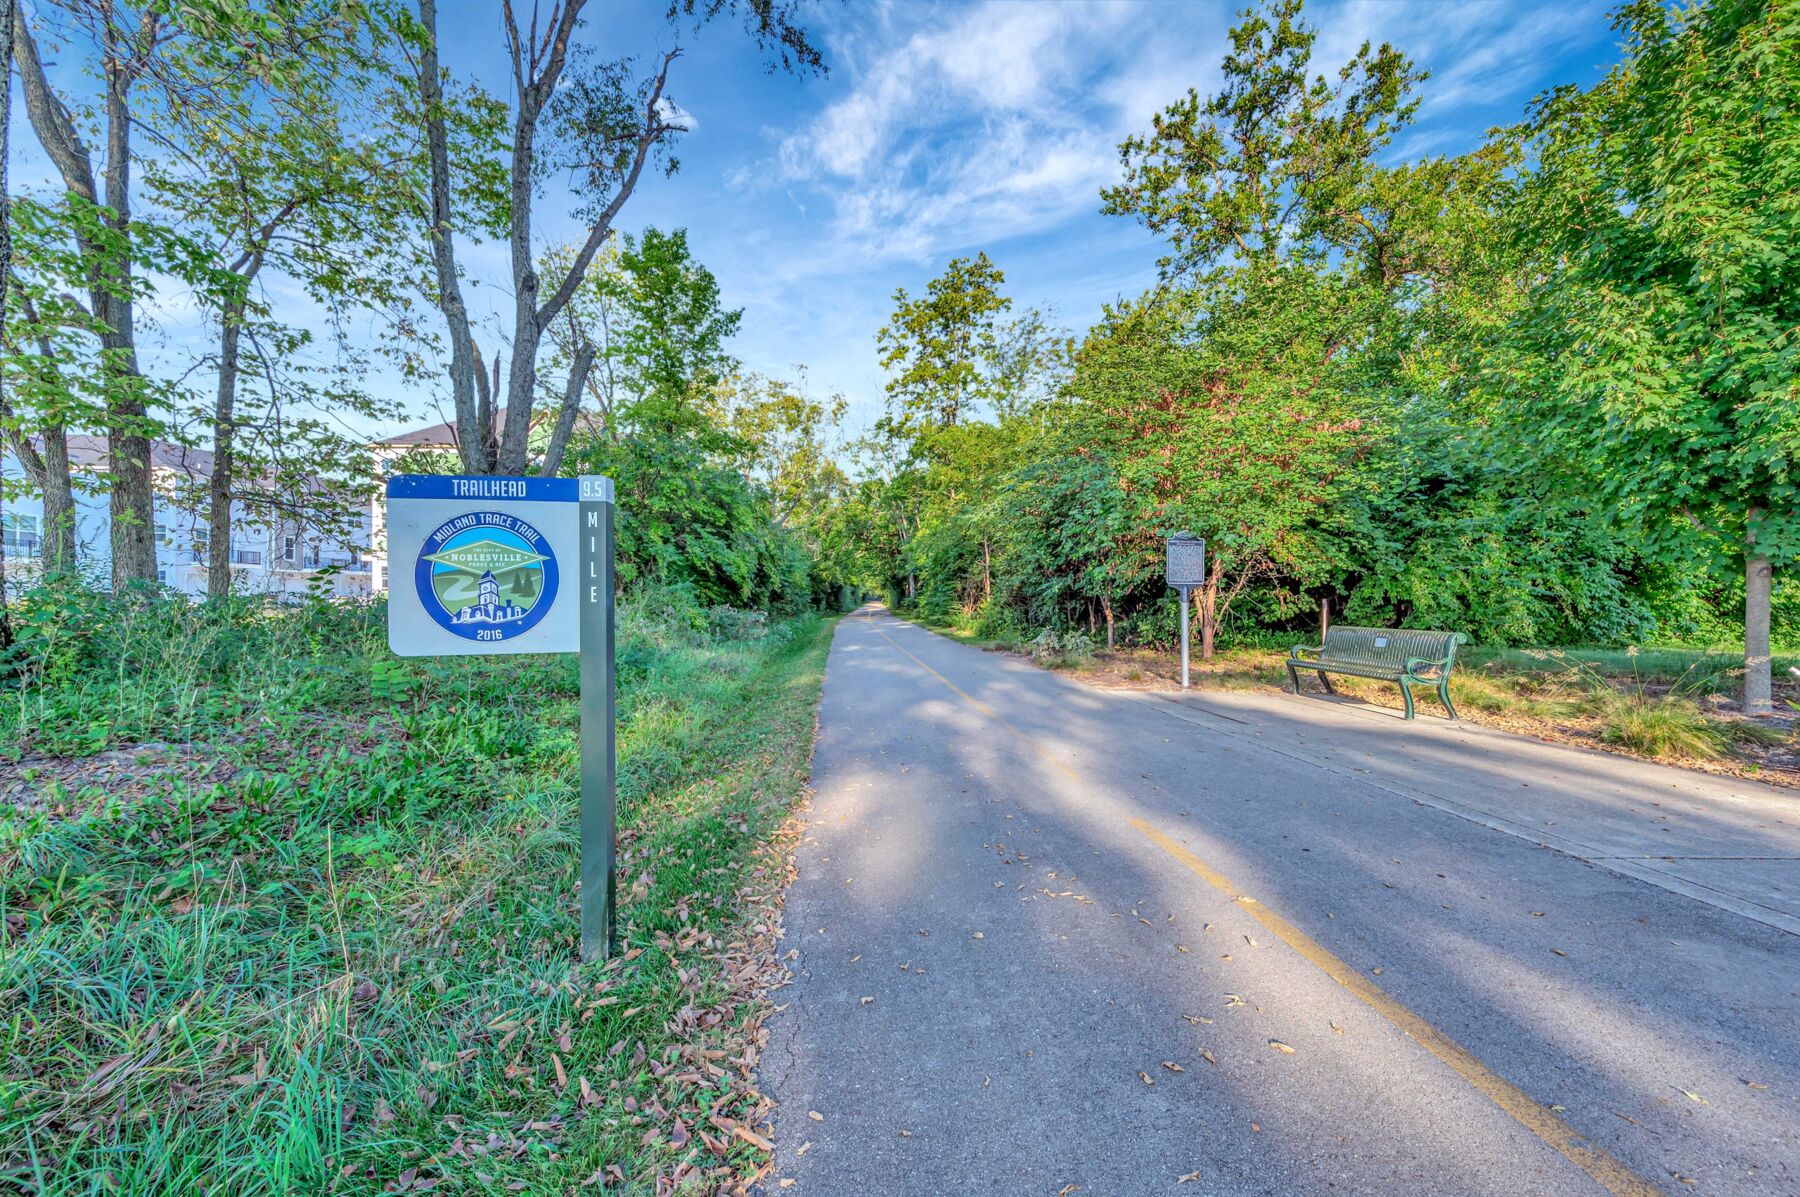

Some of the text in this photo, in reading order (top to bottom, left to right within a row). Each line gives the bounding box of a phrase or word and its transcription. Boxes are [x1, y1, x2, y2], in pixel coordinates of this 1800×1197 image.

[452, 479, 527, 497] TRAILHEAD
[583, 481, 602, 497] 9.5
[432, 513, 541, 545] MIDLAND TRACE TRAIL
[451, 553, 522, 561] NOBLESVILLE
[587, 511, 598, 603] MILE
[477, 629, 503, 641] 2016
